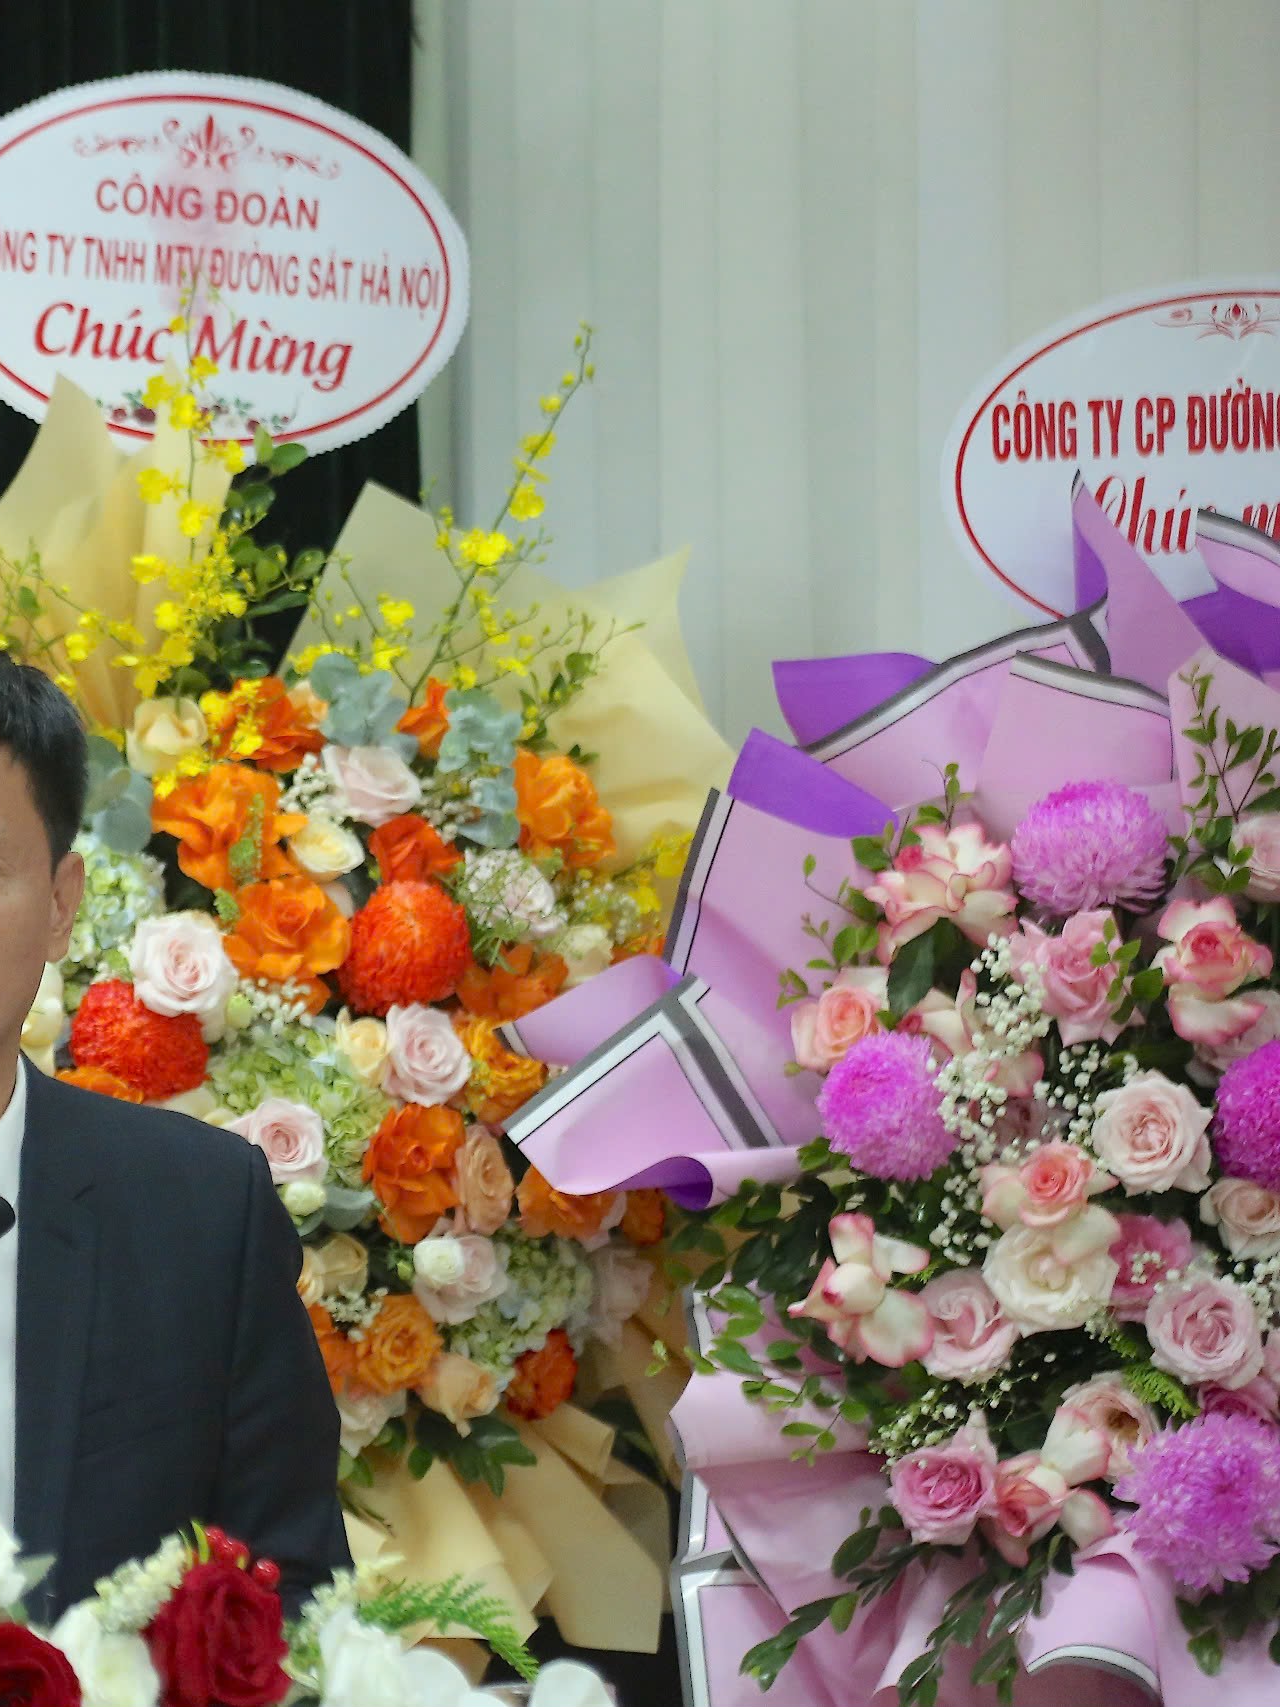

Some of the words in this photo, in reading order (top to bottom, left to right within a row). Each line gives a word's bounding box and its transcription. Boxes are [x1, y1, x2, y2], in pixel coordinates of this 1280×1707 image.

[95, 172, 203, 221] CÔNG
[215, 185, 319, 231] ĐOÀN
[46, 233, 75, 277] TY
[84, 236, 147, 283] TNHH
[154, 243, 206, 289] MTV
[209, 240, 300, 297] ĐƯỜNG
[307, 247, 354, 304] SẮT
[360, 251, 391, 306] HÀ
[399, 261, 439, 320] NỘI
[34, 301, 174, 364] Chúc
[190, 315, 354, 393] Mừng
[992, 389, 1077, 464] CÔNG
[1088, 398, 1123, 460] TY
[1135, 396, 1176, 458] CP
[1187, 377, 1280, 455] ĐƯỜN
